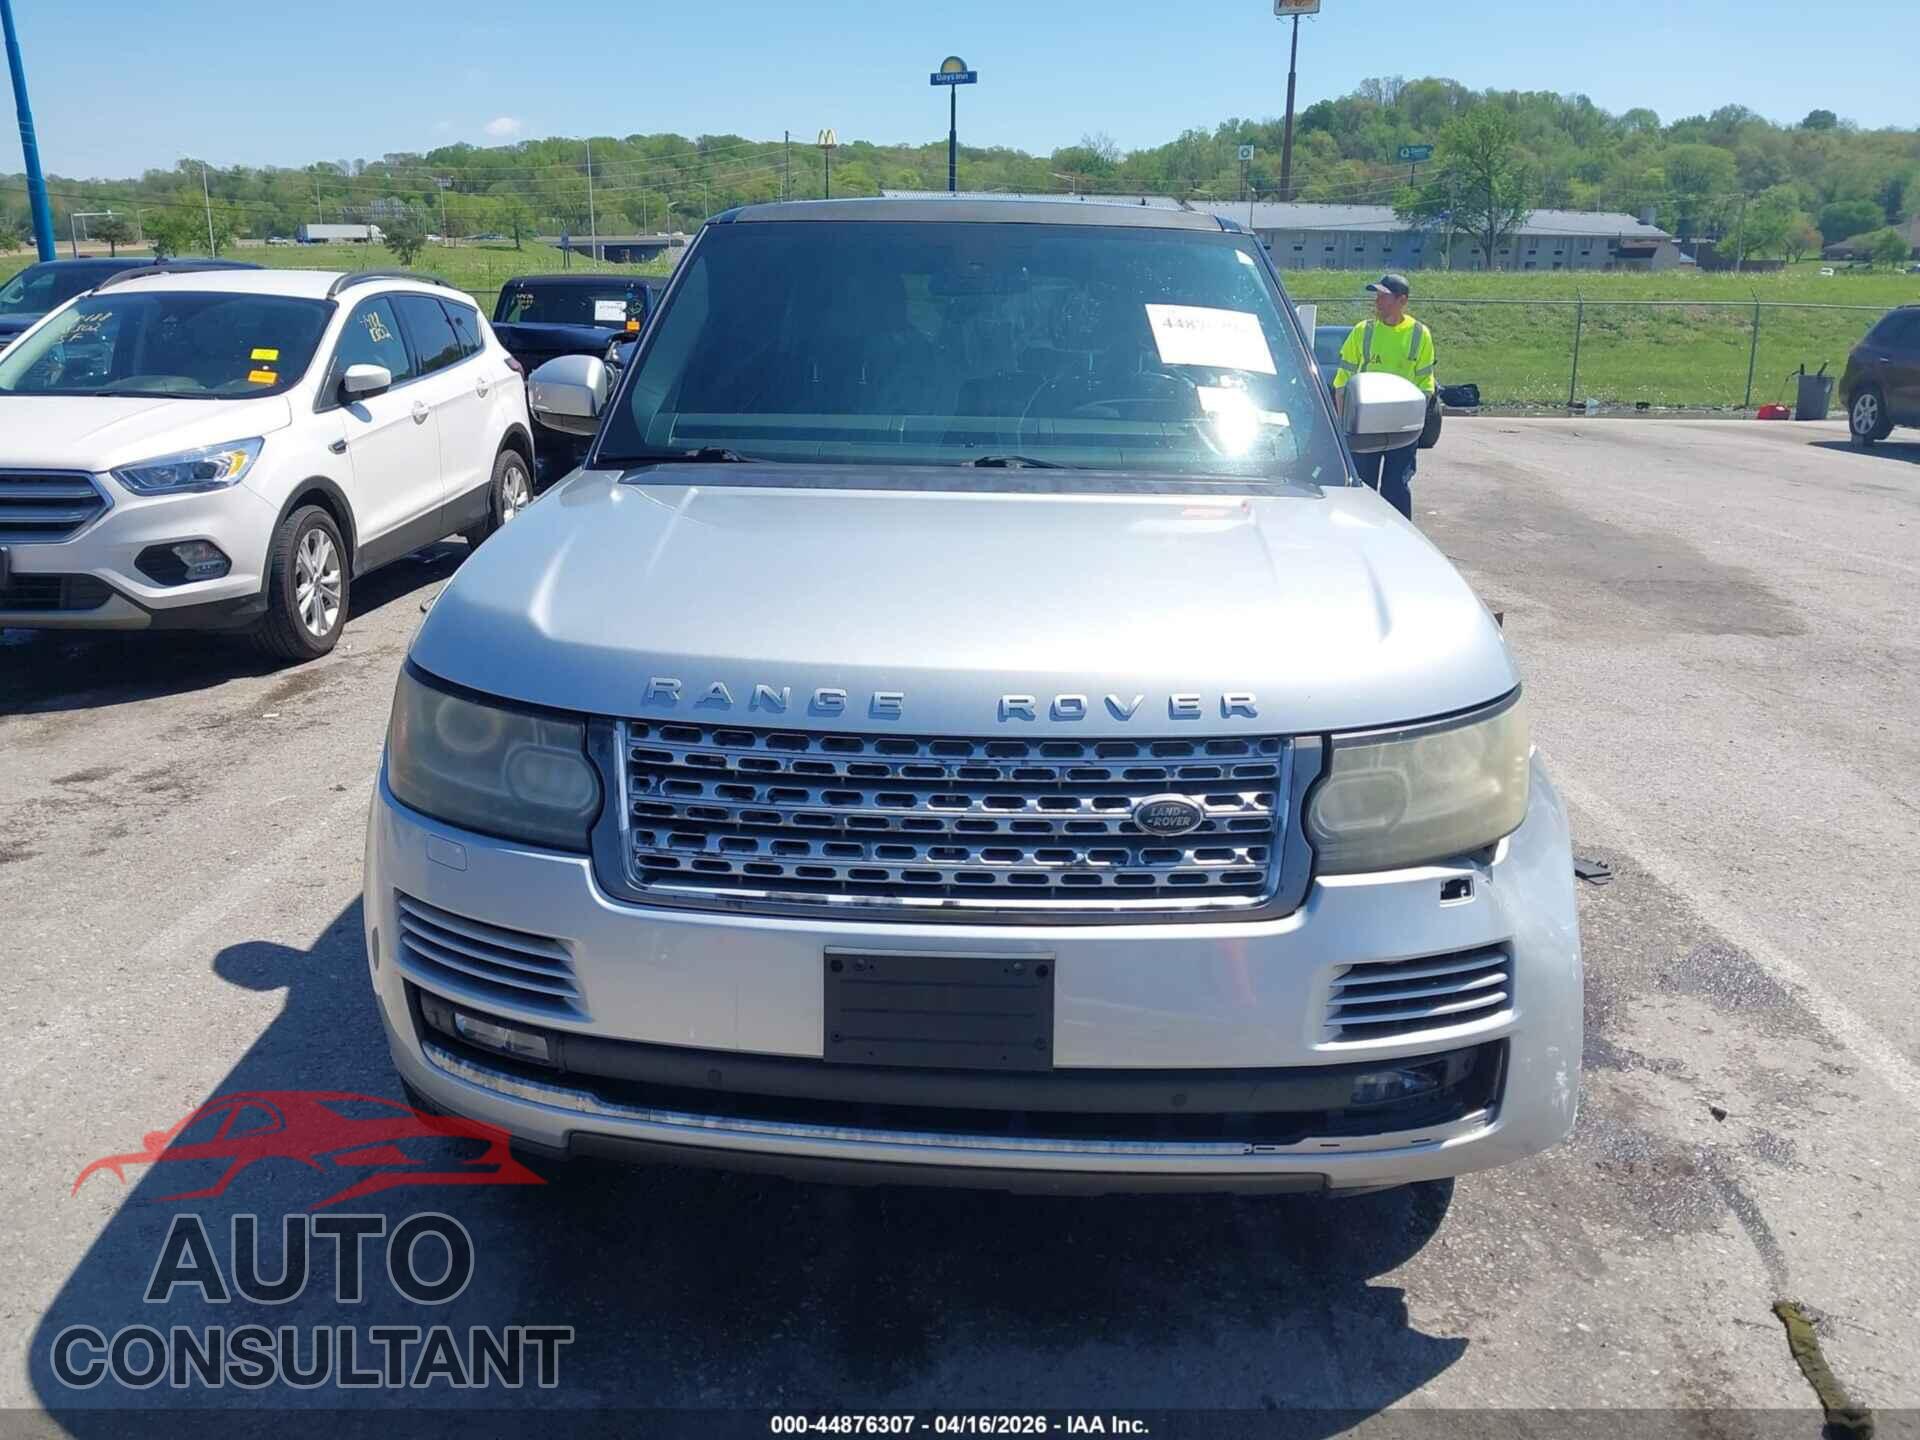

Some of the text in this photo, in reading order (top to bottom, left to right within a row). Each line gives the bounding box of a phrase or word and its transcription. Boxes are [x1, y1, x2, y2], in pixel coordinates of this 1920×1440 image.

[645, 677, 1259, 721] RANGE ROVER
[1151, 807, 1181, 817] LAND
[1153, 816, 1192, 826] ROVER
